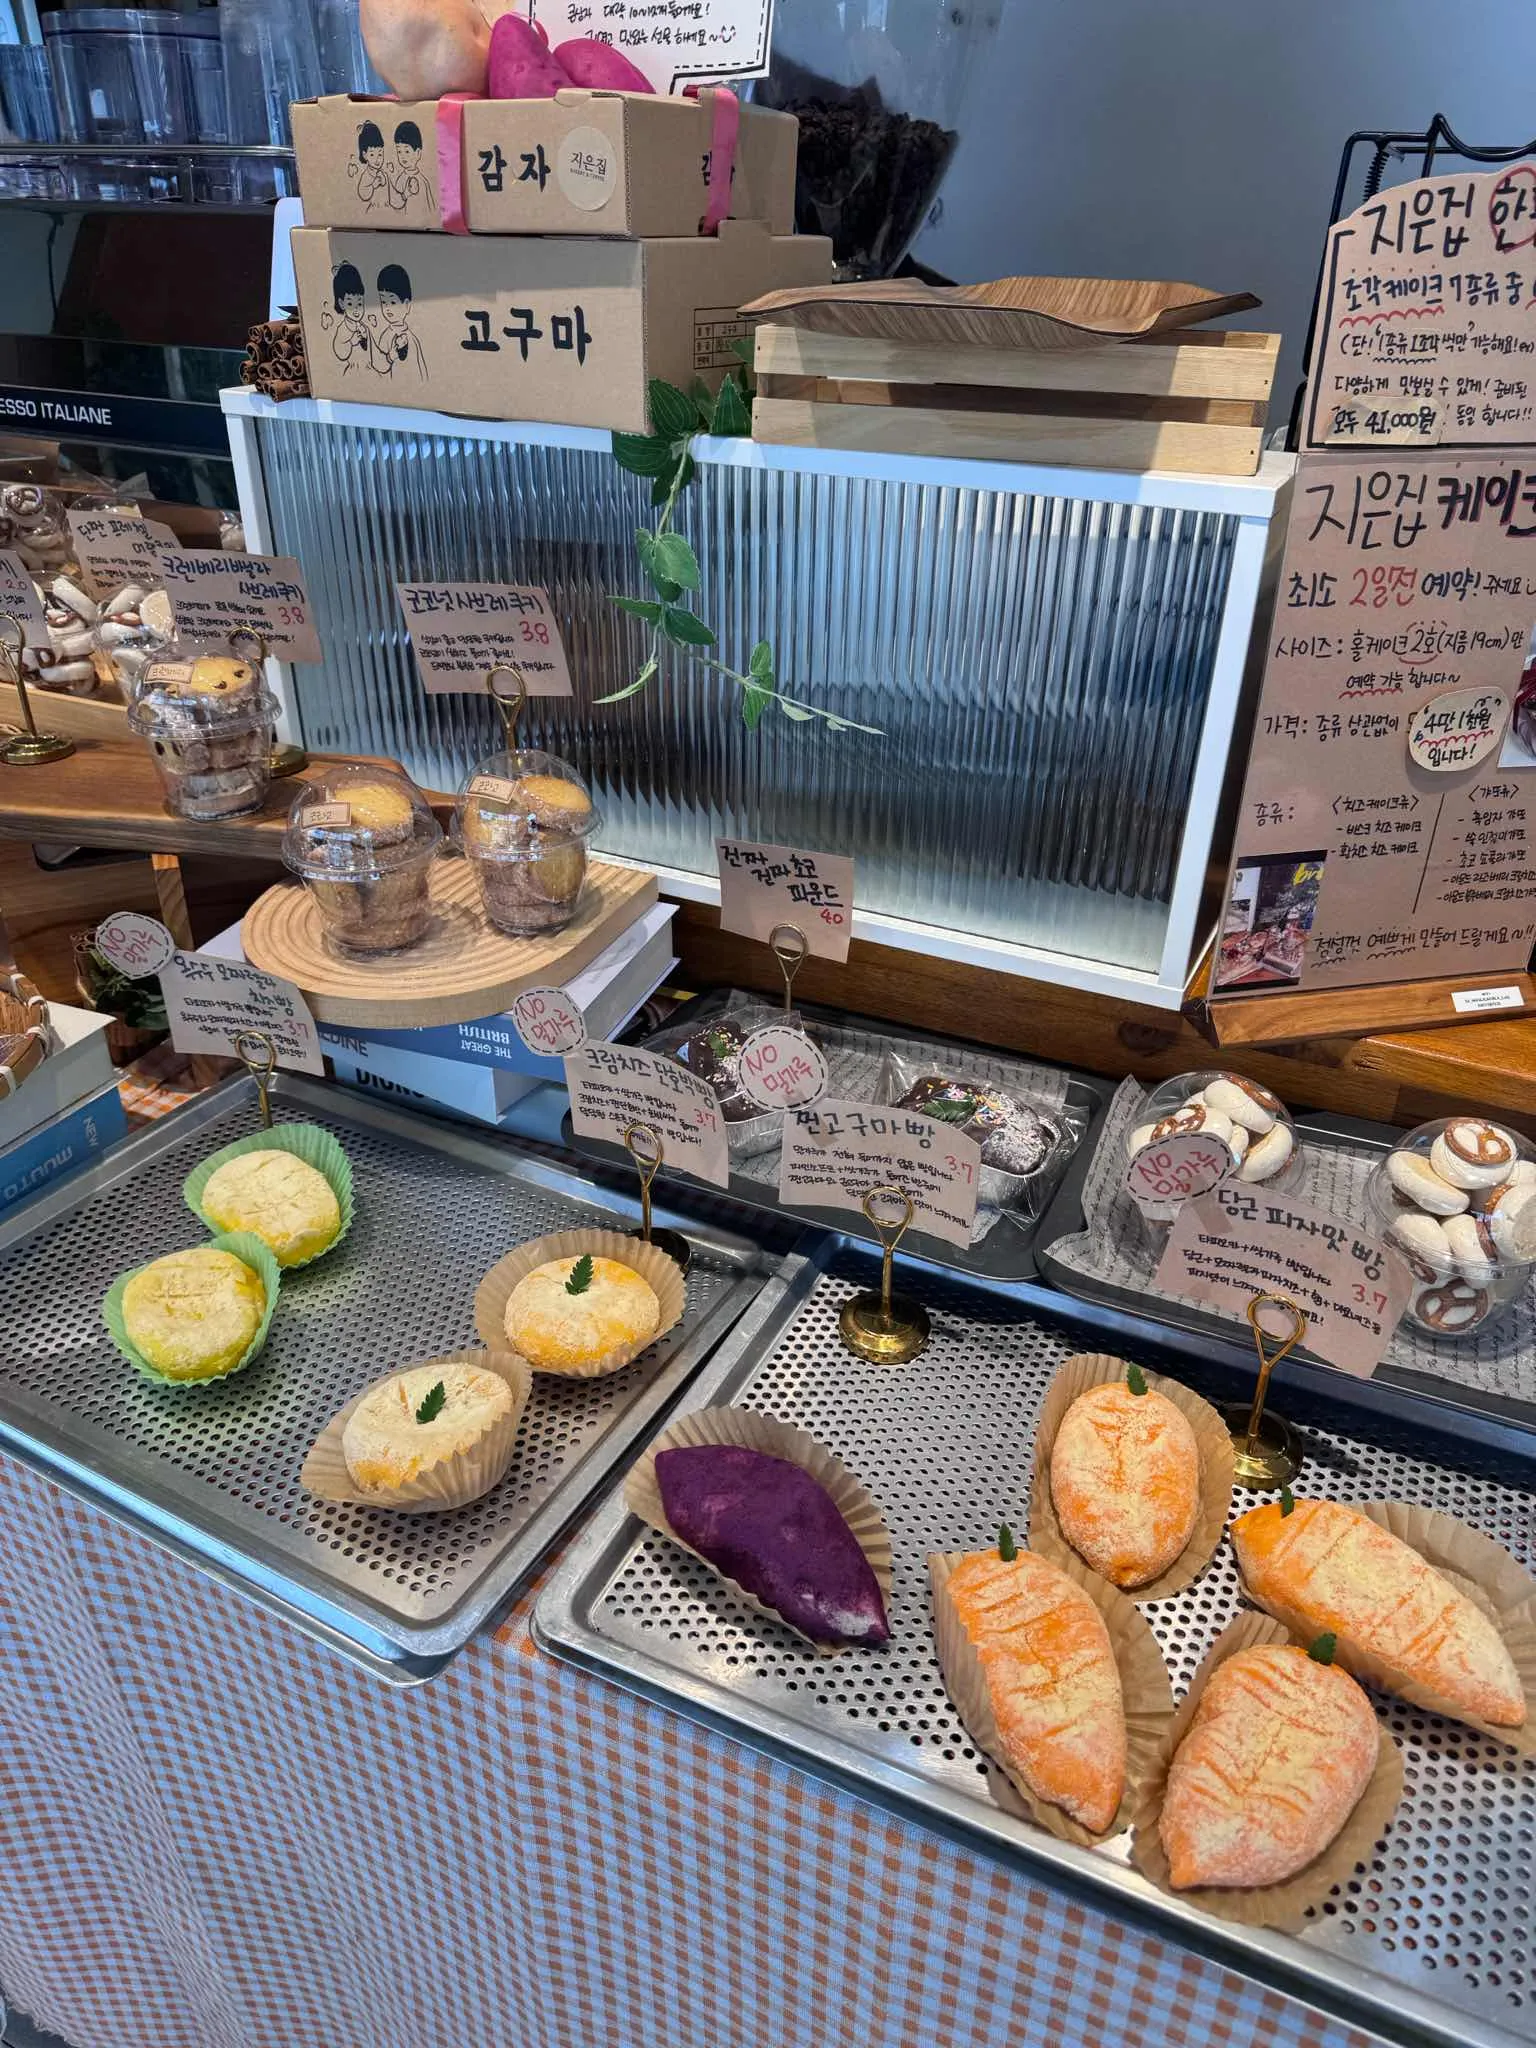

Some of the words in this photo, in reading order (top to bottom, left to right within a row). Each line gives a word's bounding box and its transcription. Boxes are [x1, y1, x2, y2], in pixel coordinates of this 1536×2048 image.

[650, 26, 672, 46] 선물
[570, 151, 607, 176] 지은집
[1362, 182, 1476, 258] 지은집
[1490, 176, 1536, 252] 한
[1341, 274, 1443, 312] 조각케이크
[1506, 270, 1524, 305] 중
[460, 305, 593, 367] 고구마
[1334, 375, 1389, 395] 다양하게
[1399, 376, 1434, 397] 맛보실
[1438, 376, 1449, 396] 수
[1493, 378, 1527, 400] 준비된
[40, 402, 113, 426] ITALIANE
[1364, 405, 1437, 435] 41,000원
[1456, 403, 1477, 427] 동일
[1305, 470, 1428, 550] 지은집
[1287, 570, 1338, 609] 최소
[1349, 565, 1418, 609] 2일전
[278, 605, 306, 626] 3.8
[519, 620, 550, 645] 3.8
[1350, 629, 1409, 662] 홀케이크
[1346, 671, 1376, 689] 예약
[1380, 670, 1404, 688] 가능
[1315, 715, 1341, 742] 종류
[1349, 712, 1399, 739] 상관없이
[1428, 743, 1477, 767] 입니다!
[1394, 820, 1422, 833] 케이크
[1472, 810, 1503, 826] 흑임자
[1391, 841, 1419, 854] 케이크
[786, 882, 844, 908] 파운드
[104, 926, 126, 957] NO
[122, 929, 162, 965] 밀가루
[1367, 928, 1416, 951] 예쁘게
[1420, 929, 1456, 948] 만들어
[173, 955, 215, 982] 옥수수
[518, 998, 545, 1021] NO
[530, 1009, 577, 1046] 밀가루
[460, 1039, 492, 1055] GREAT
[493, 1046, 512, 1059] THE
[745, 1044, 779, 1077] NO
[585, 1049, 652, 1076] 크림치즈
[653, 1060, 716, 1110] 단호박빵
[762, 1055, 815, 1095] 밀가루
[694, 1108, 717, 1132] 3.7
[944, 1155, 974, 1184] 3.7
[1137, 1152, 1172, 1184] NO
[1152, 1151, 1221, 1196] 밀가루
[1218, 1189, 1259, 1221] 당근
[1265, 1206, 1349, 1252] 피자맛
[1351, 1239, 1385, 1282] 빵
[1351, 1283, 1388, 1315] 3.7
